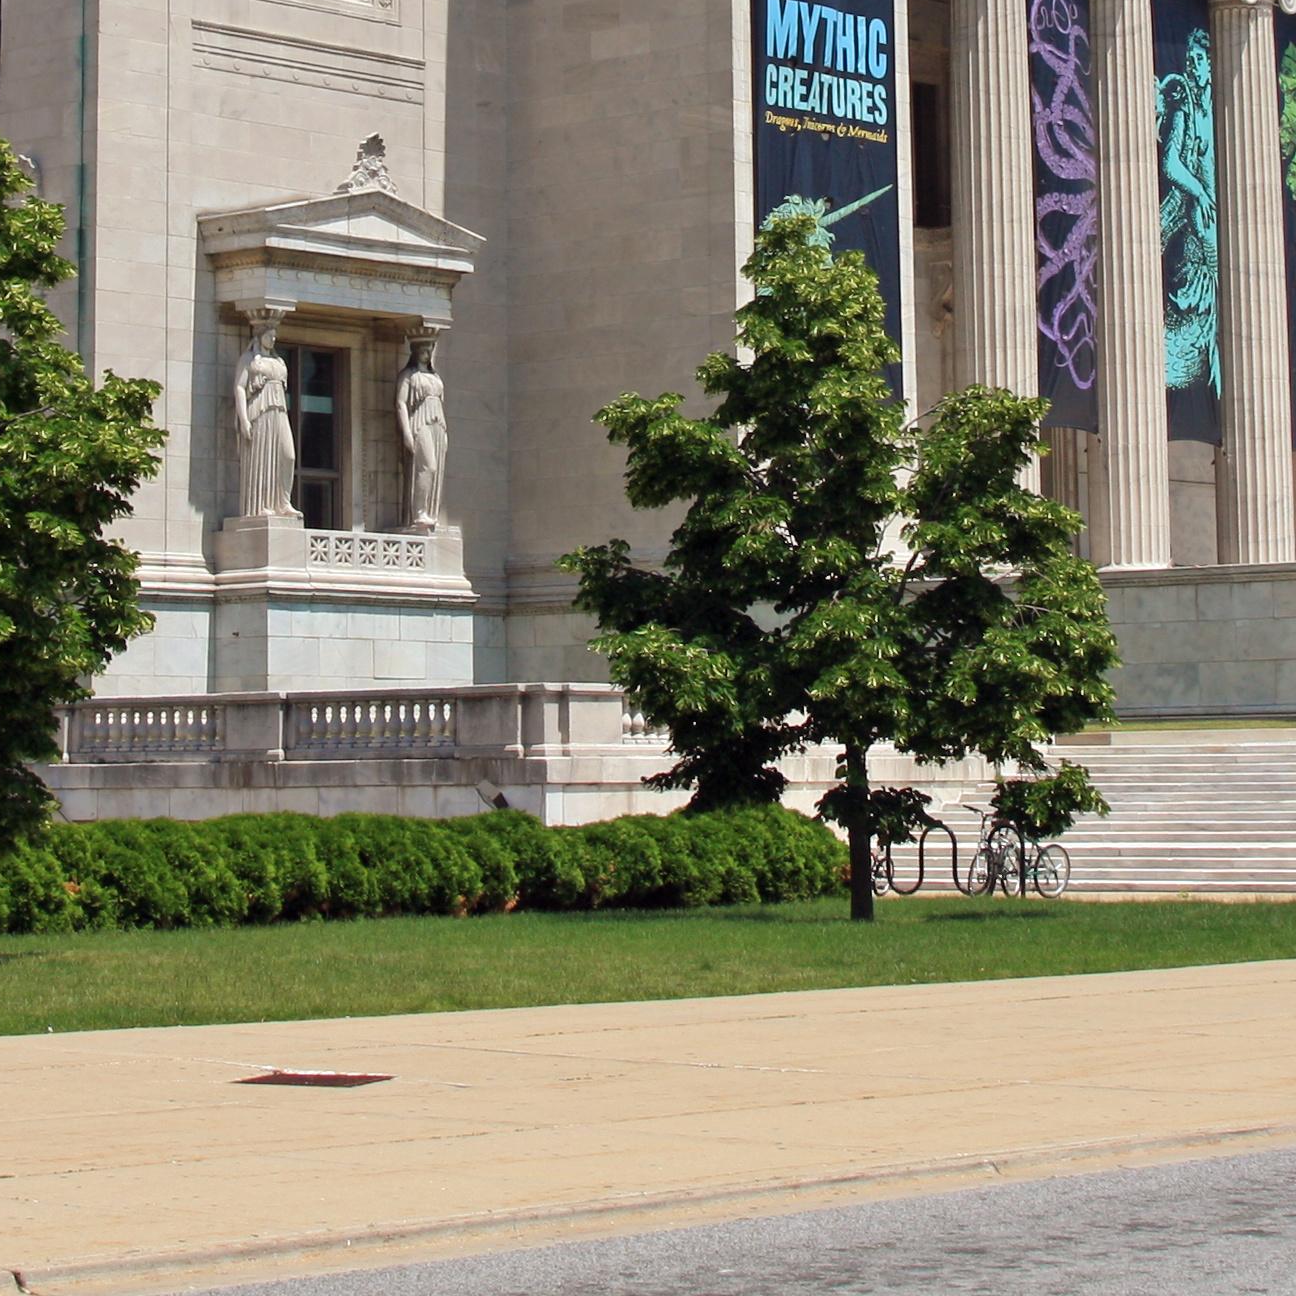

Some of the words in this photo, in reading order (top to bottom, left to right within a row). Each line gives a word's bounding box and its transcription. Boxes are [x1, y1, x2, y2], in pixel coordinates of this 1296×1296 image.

[765, 63, 888, 126] CREATURES
[836, 122, 847, 137] &
[847, 125, 888, 143] Mermaids
